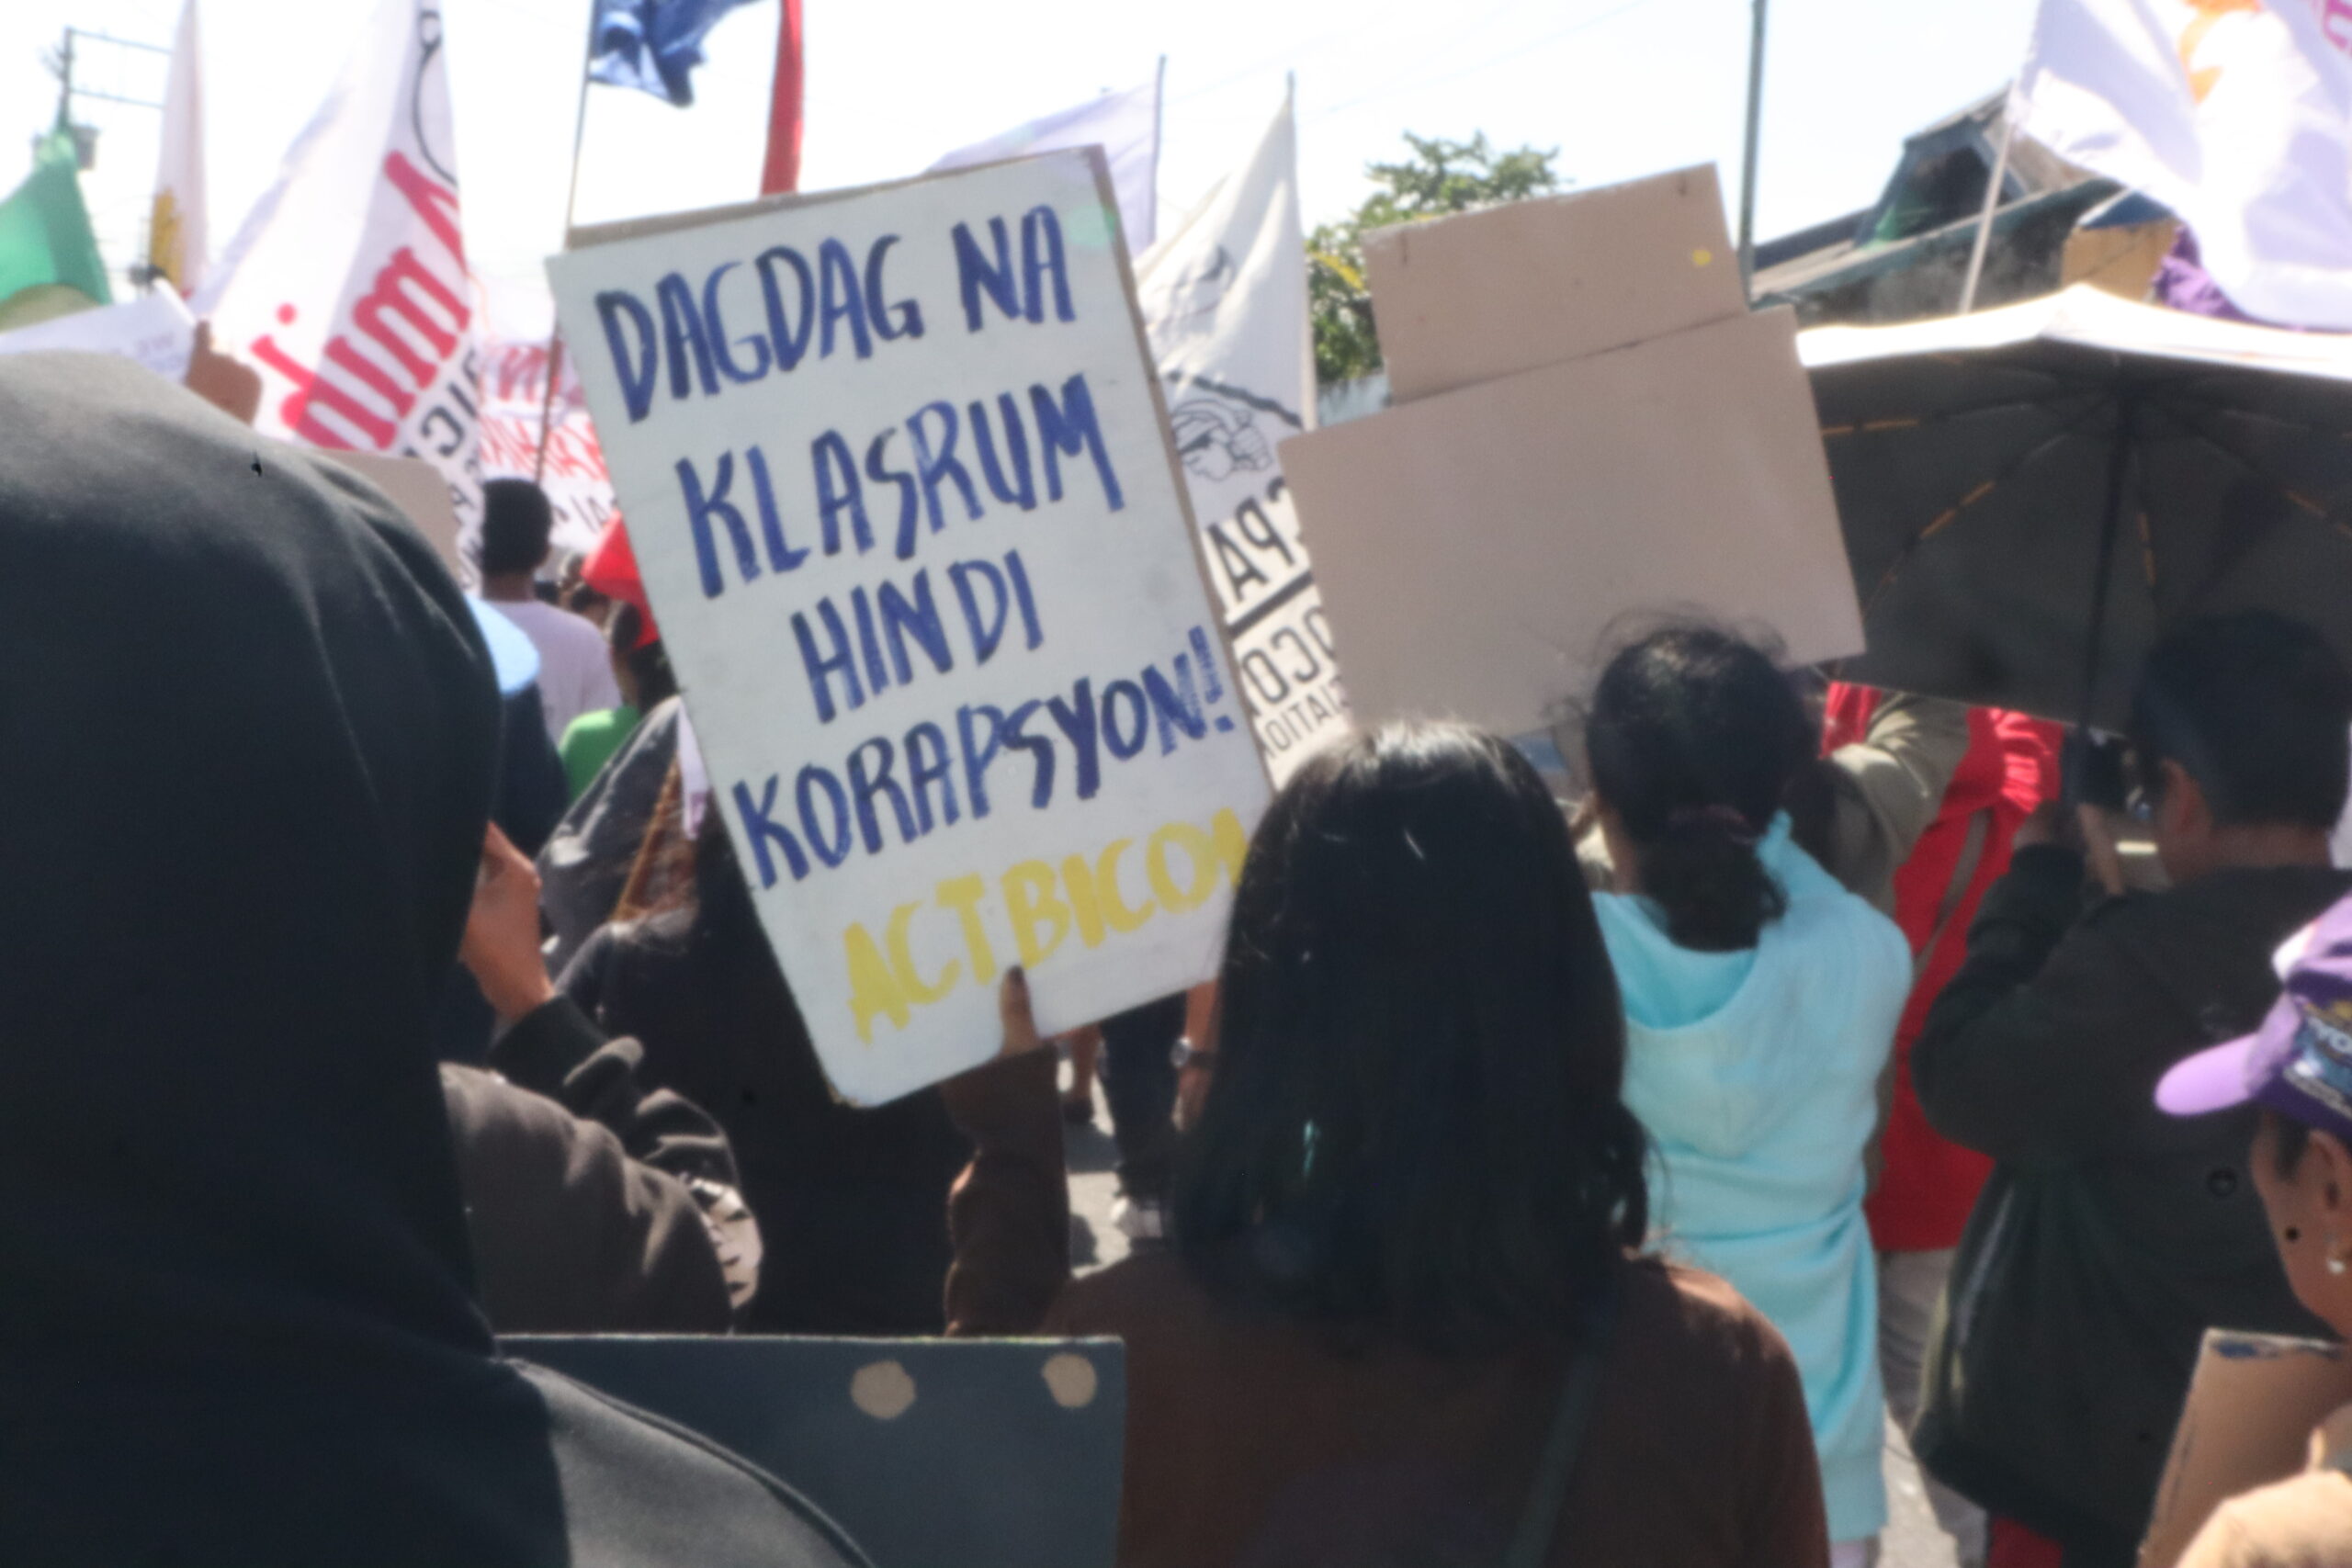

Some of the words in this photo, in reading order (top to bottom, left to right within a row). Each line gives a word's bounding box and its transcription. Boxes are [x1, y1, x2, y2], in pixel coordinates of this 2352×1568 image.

[595, 234, 924, 423] DAGDAG
[951, 204, 1076, 333] NA
[674, 373, 1125, 599] KLASRUM
[790, 548, 1044, 725] HINDI
[731, 625, 1235, 890] KORAPSYON!
